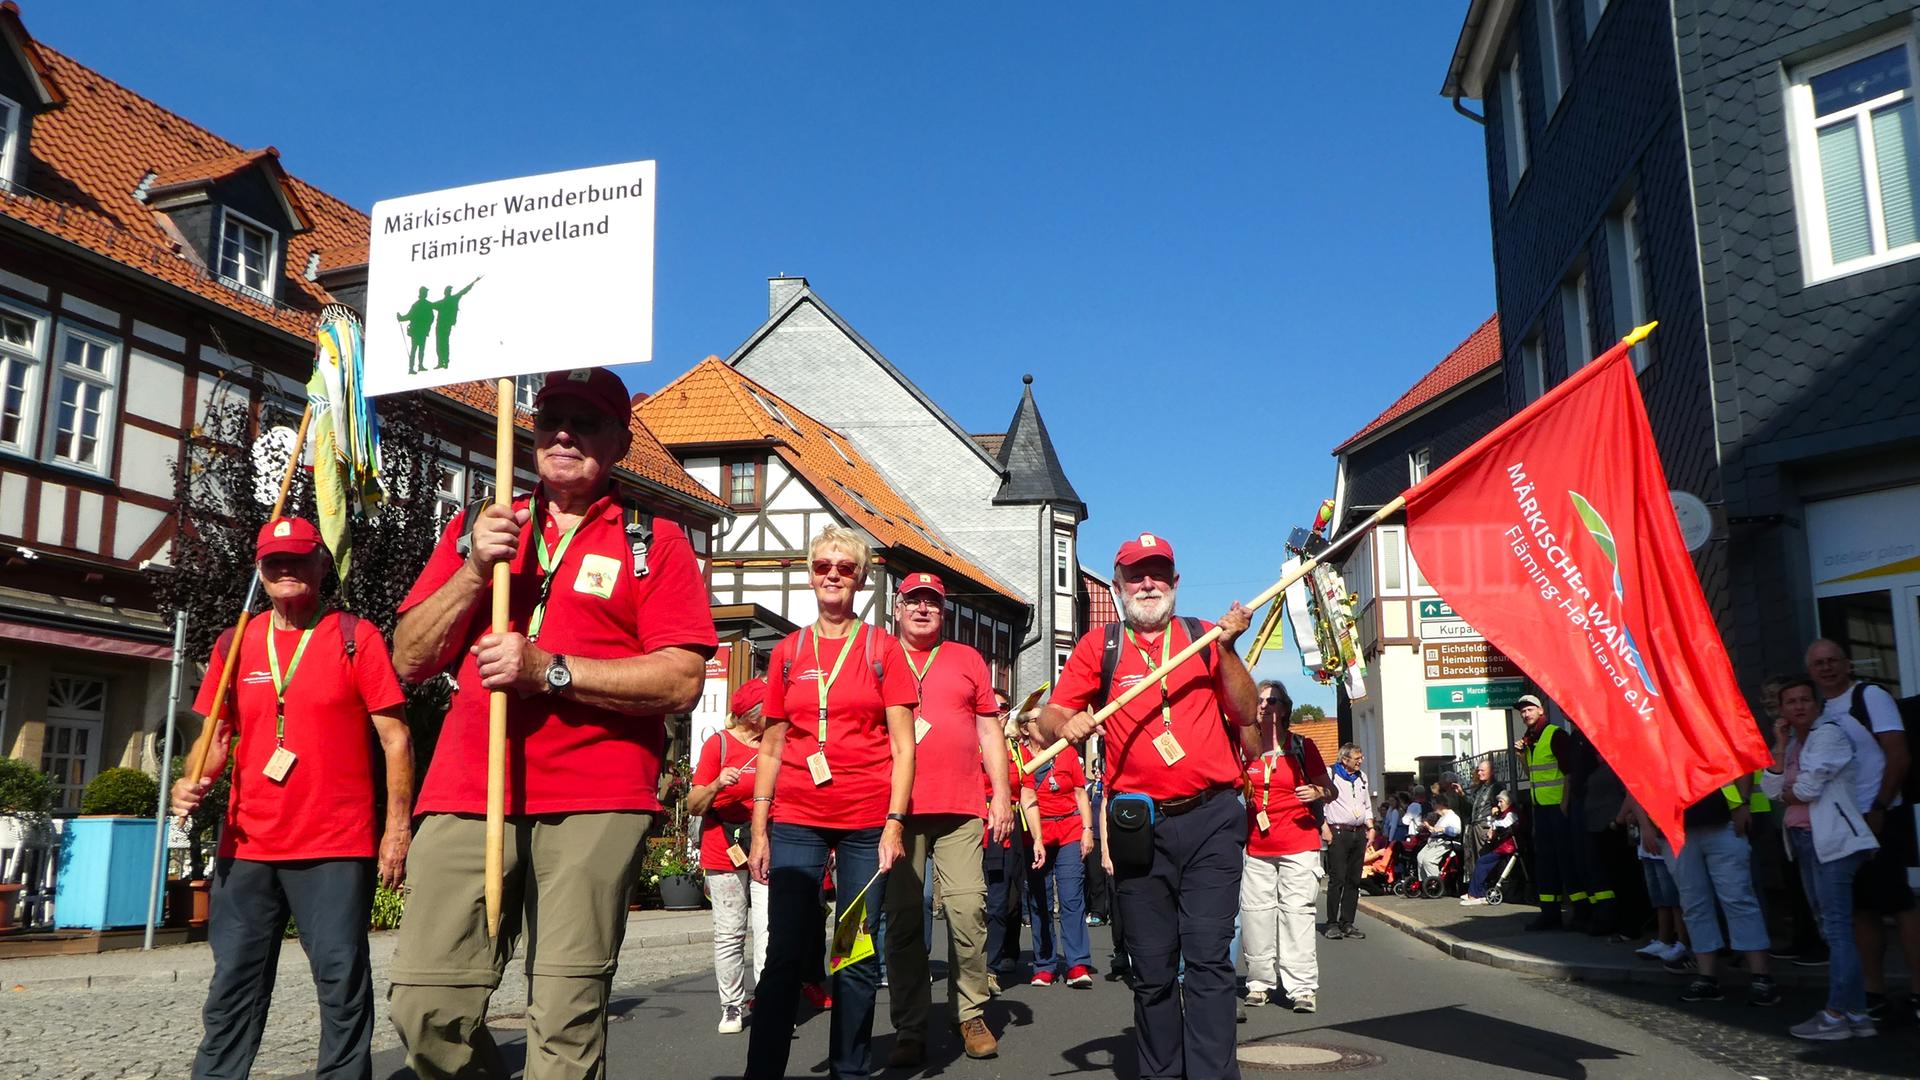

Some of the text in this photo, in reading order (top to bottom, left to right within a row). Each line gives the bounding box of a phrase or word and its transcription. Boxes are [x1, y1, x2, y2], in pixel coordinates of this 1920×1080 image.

[384, 178, 643, 235] Märkischer Wanderbund
[411, 215, 609, 262] Fläming-Havelland
[1441, 644, 1492, 653] Eichsfelder
[1443, 665, 1504, 675] Barockgarten
[1624, 689, 1656, 721] e.V.
